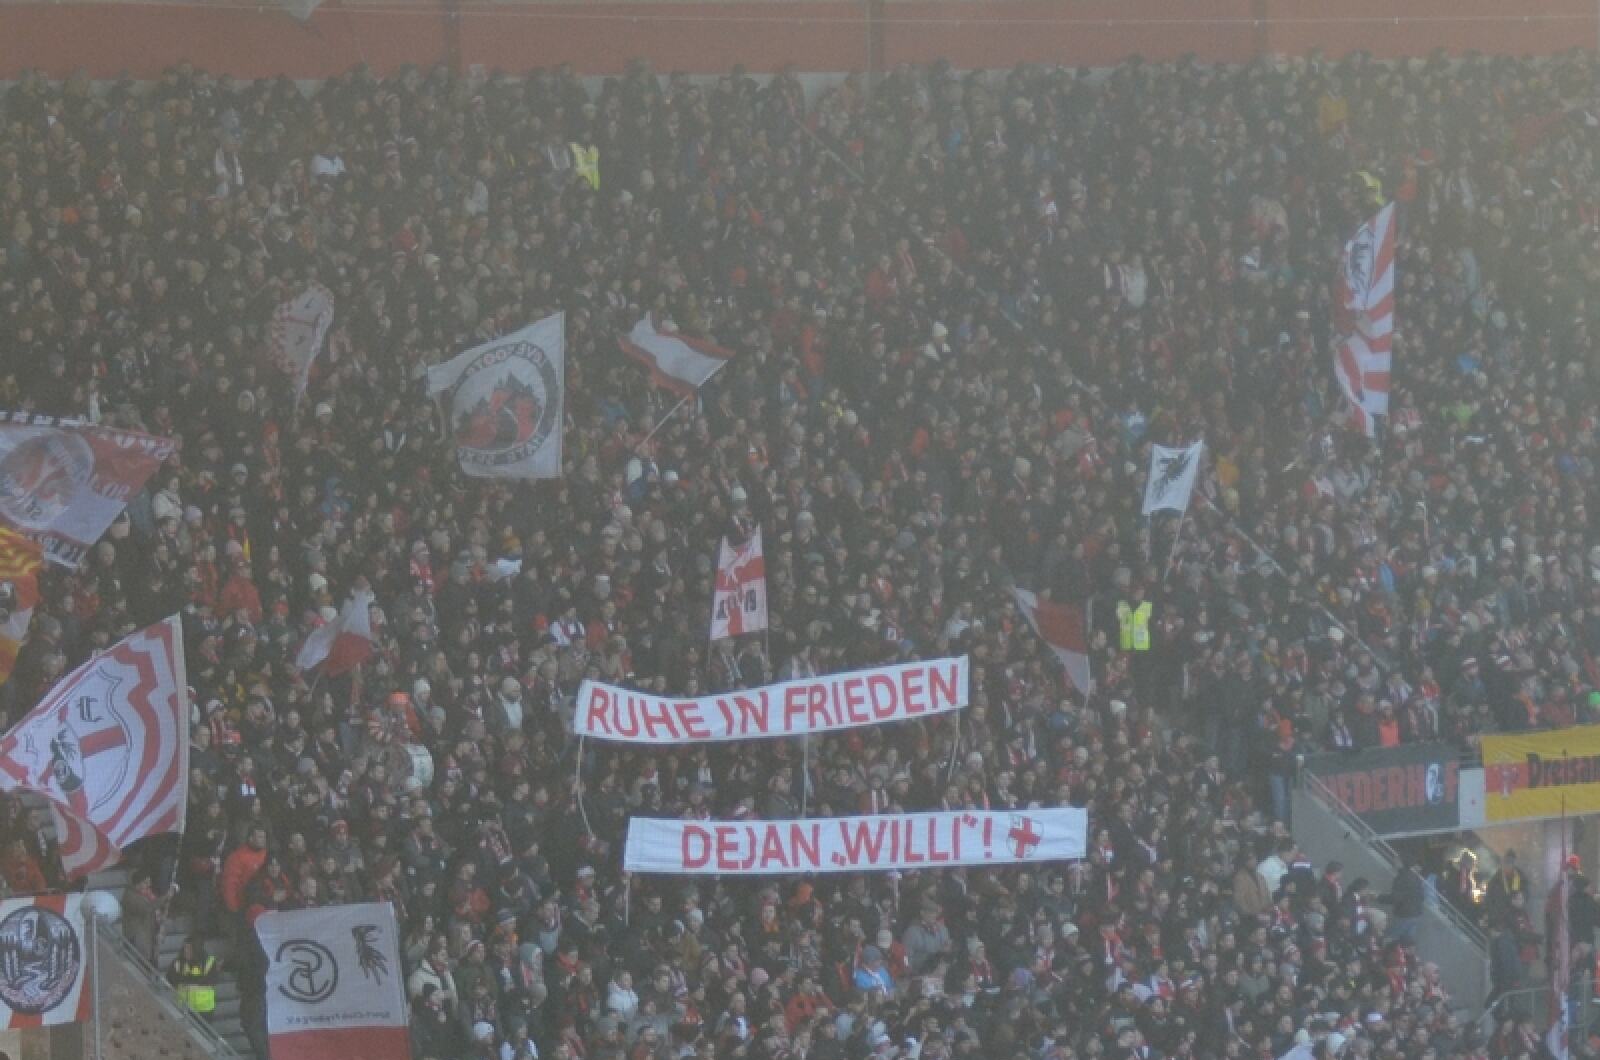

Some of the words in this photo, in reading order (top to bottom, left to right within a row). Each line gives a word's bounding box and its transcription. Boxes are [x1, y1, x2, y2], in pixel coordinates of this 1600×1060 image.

[586, 688, 711, 739] RUHE
[717, 693, 769, 735] IN
[783, 664, 959, 731] FRIEDEN
[681, 822, 821, 871] DEJAN
